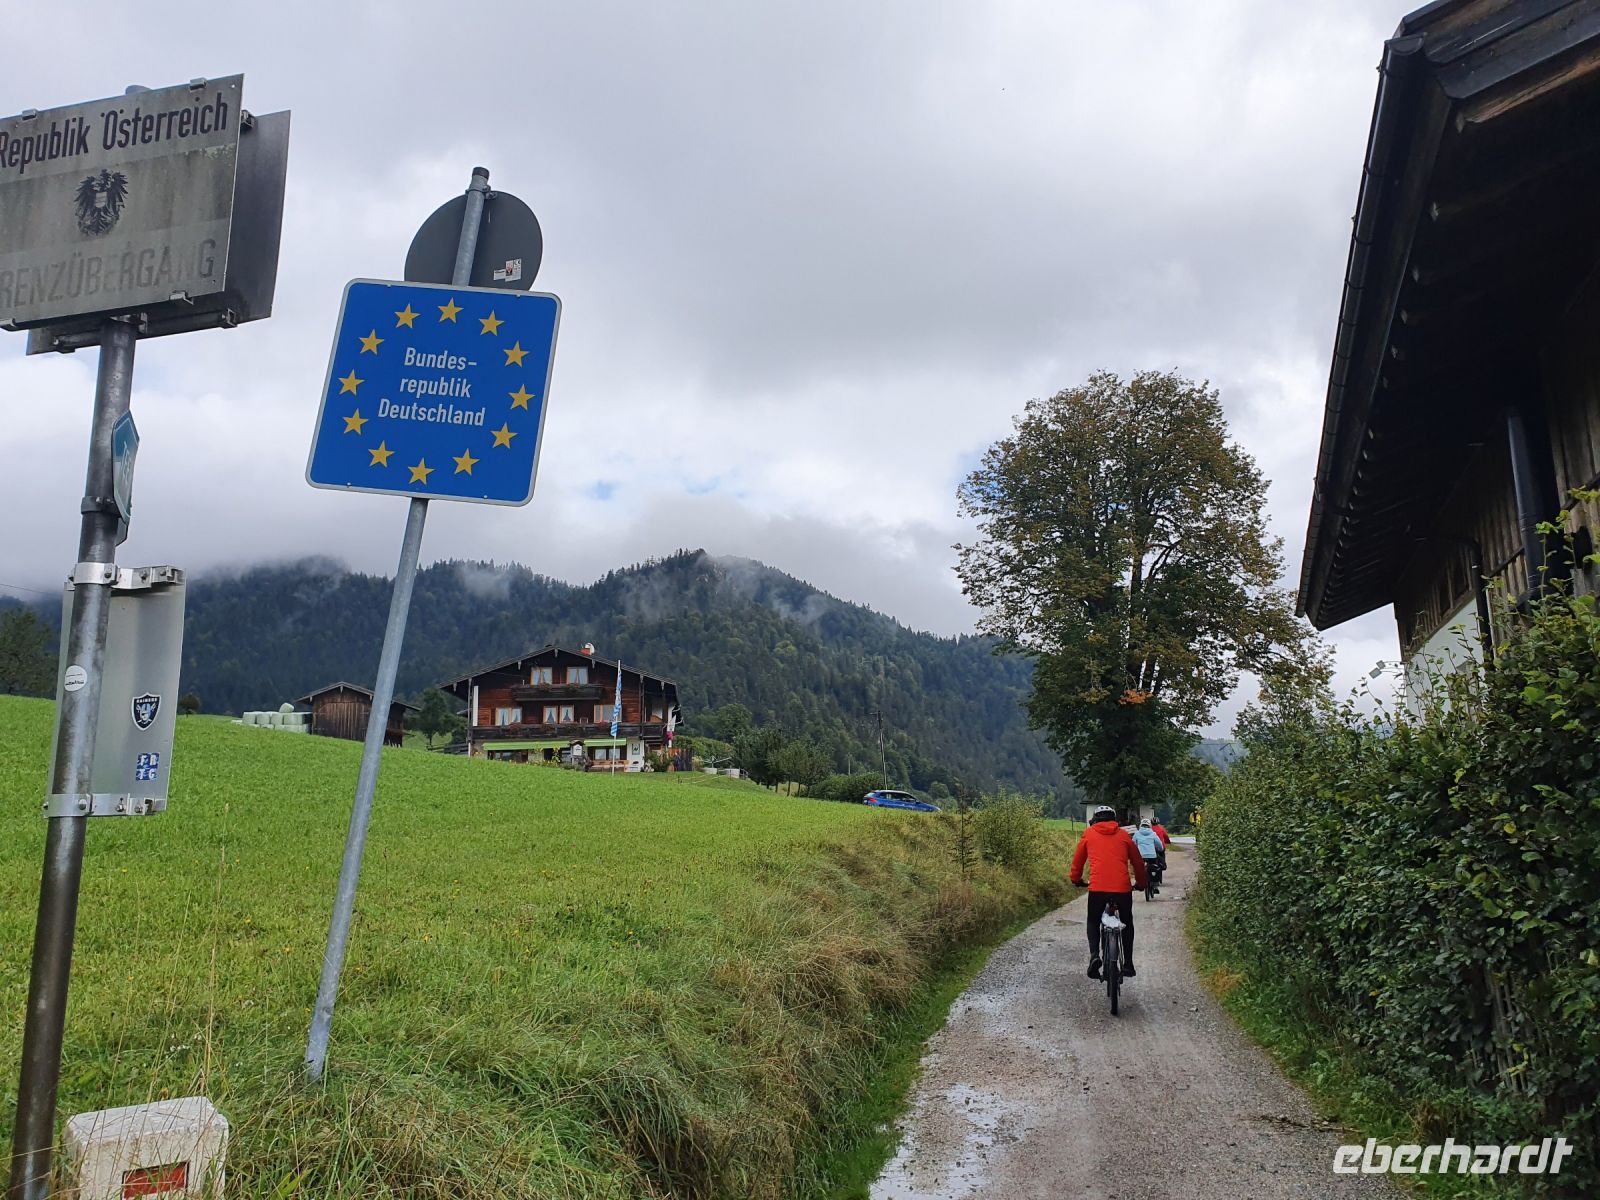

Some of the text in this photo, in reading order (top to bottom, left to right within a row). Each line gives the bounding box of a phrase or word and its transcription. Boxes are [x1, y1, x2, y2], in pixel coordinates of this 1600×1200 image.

[0, 92, 229, 174] Republik Österreich
[404, 347, 477, 370] Bundes-
[400, 376, 472, 399] republik
[378, 398, 486, 426] Deutschland
